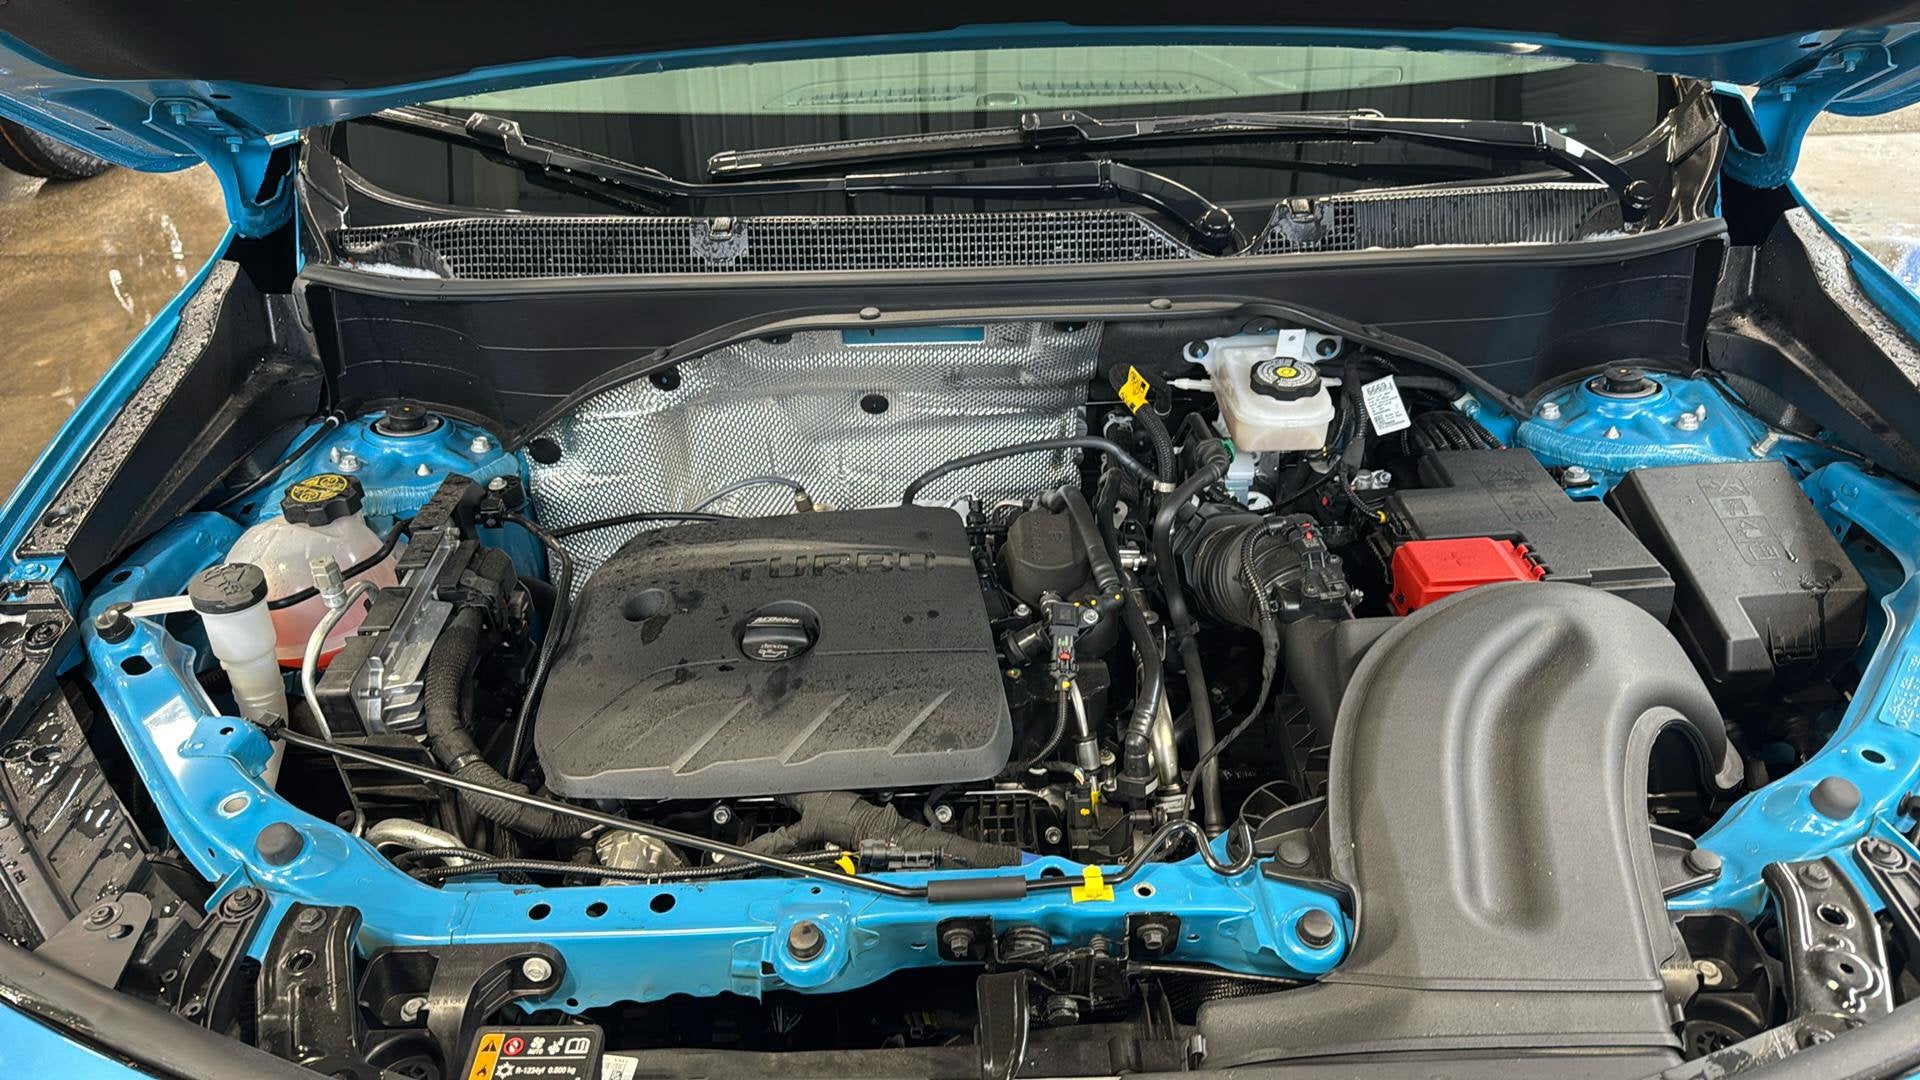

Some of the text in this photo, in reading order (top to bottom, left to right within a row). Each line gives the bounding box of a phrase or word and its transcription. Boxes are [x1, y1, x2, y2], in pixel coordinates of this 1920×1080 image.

[729, 552, 936, 580] TURBO
[515, 1066, 546, 1075] R-1234yf
[567, 1066, 576, 1075] kg
